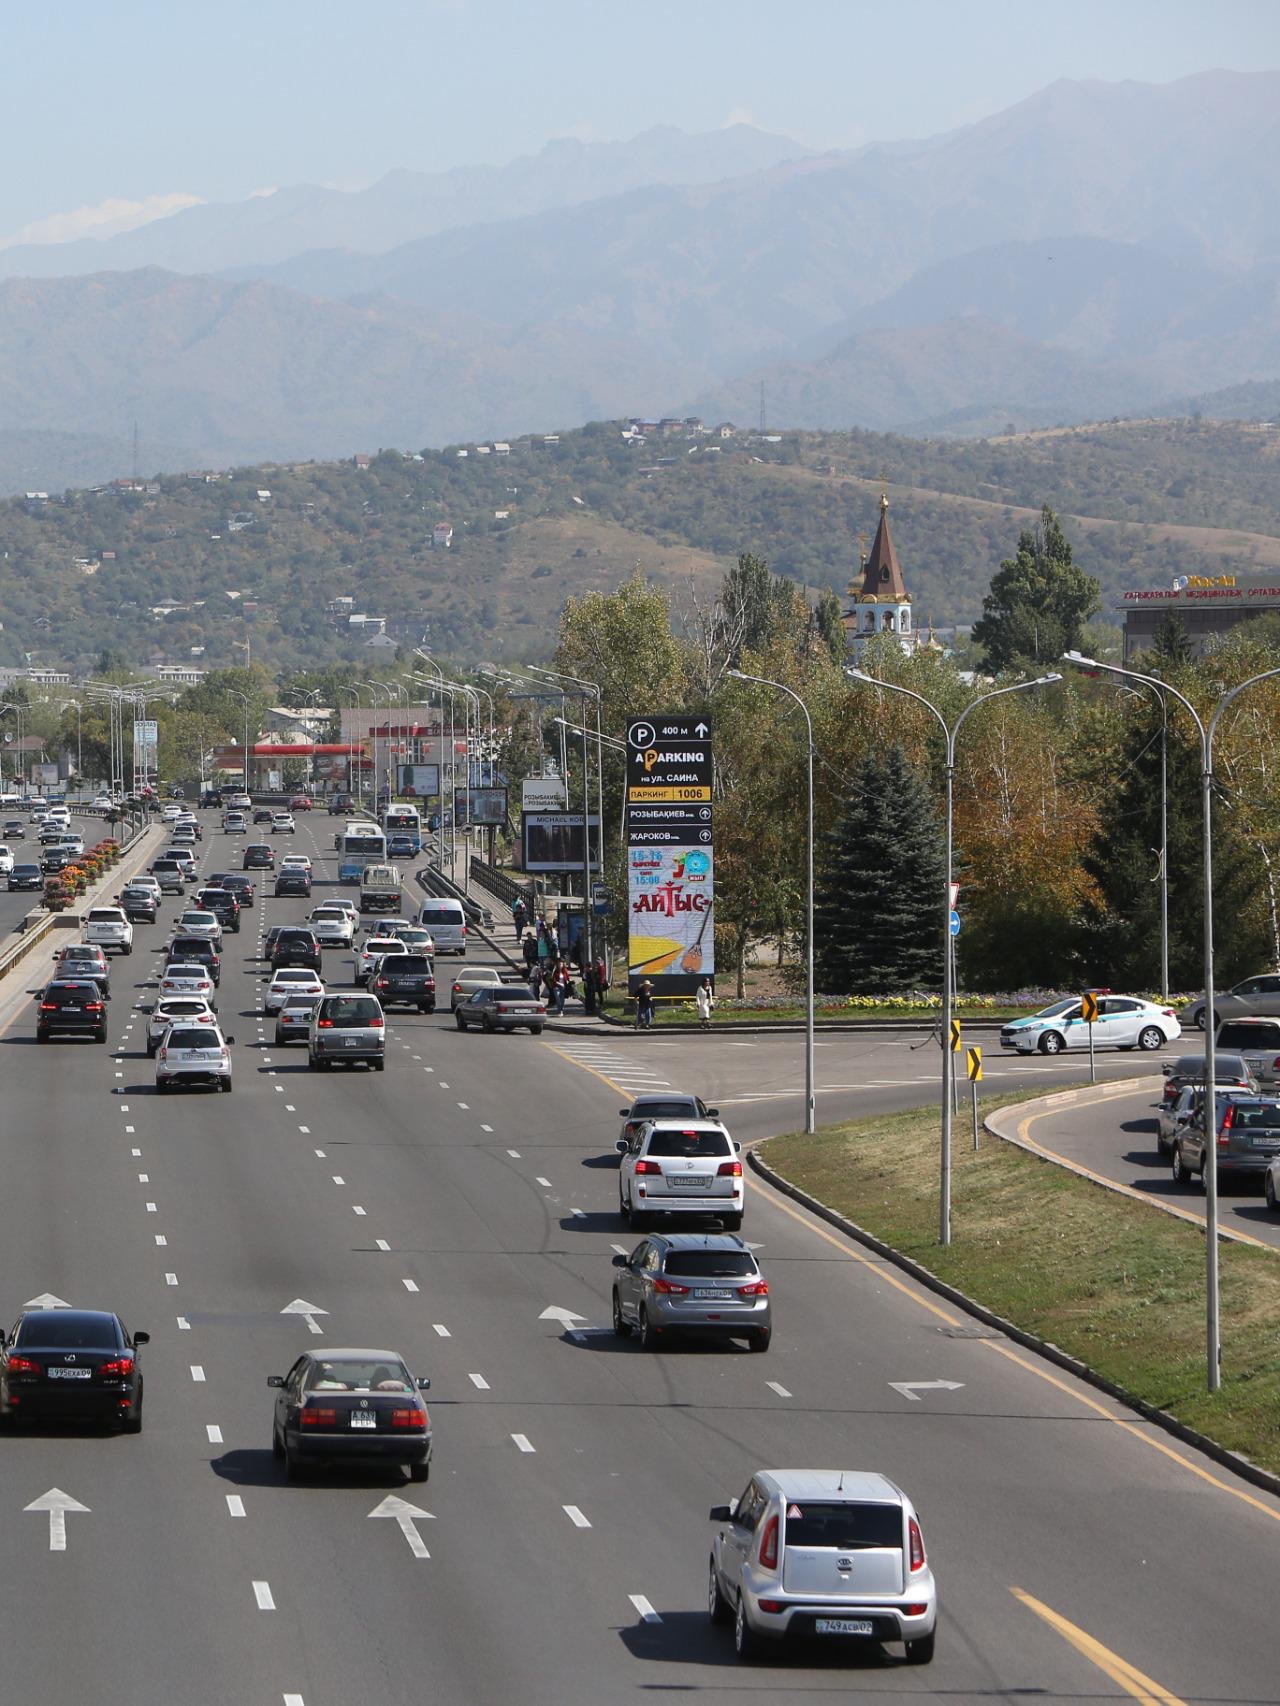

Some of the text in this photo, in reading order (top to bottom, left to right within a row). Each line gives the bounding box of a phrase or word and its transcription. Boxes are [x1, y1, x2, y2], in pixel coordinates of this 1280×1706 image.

[637, 728, 648, 742] P
[662, 726, 679, 735] 400
[651, 776, 665, 784] ул.
[666, 774, 698, 782] САИНА
[678, 789, 703, 798] 1006
[630, 832, 671, 841] ЖАРОКОВ
[632, 881, 710, 917] АЙТЫС
